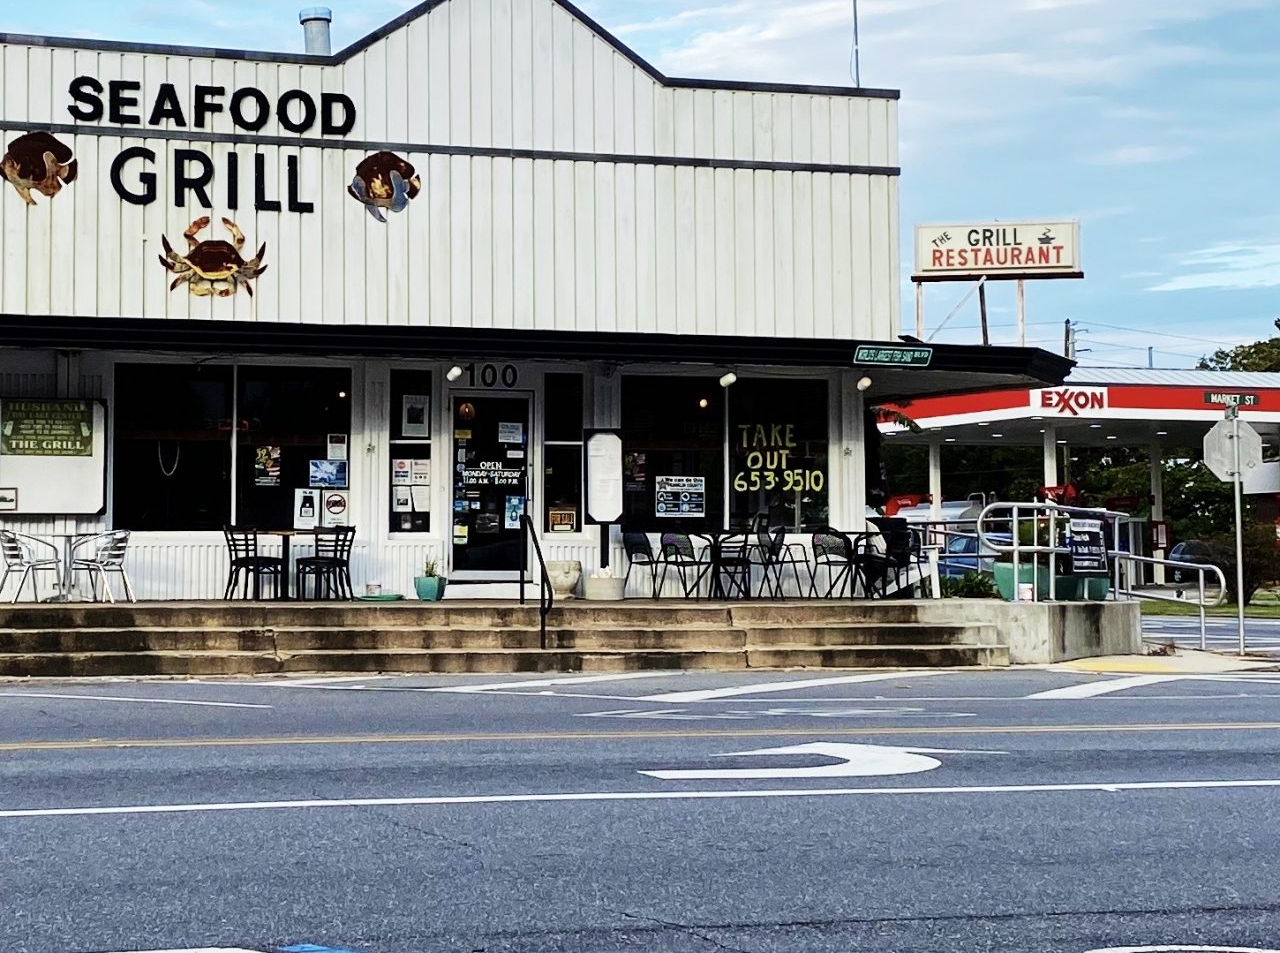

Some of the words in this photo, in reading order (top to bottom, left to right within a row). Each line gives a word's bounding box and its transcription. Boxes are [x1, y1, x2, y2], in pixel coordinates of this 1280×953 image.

[67, 75, 357, 135] SEAFOOD
[109, 146, 315, 214] GRILL
[931, 230, 952, 248] THE
[966, 227, 1023, 247] GRILL
[931, 245, 1065, 267] RESTAURANT
[465, 363, 518, 388] 100
[1041, 388, 1105, 416] EXXON
[1210, 393, 1241, 405] MARKET
[1245, 395, 1255, 406] ST
[9, 440, 39, 450] THE
[42, 440, 85, 451] GRILL
[737, 423, 797, 448] TAKE
[479, 461, 503, 470] OPEN
[746, 449, 790, 470] OUT
[551, 513, 561, 524] FOR
[561, 512, 574, 524] SALE
